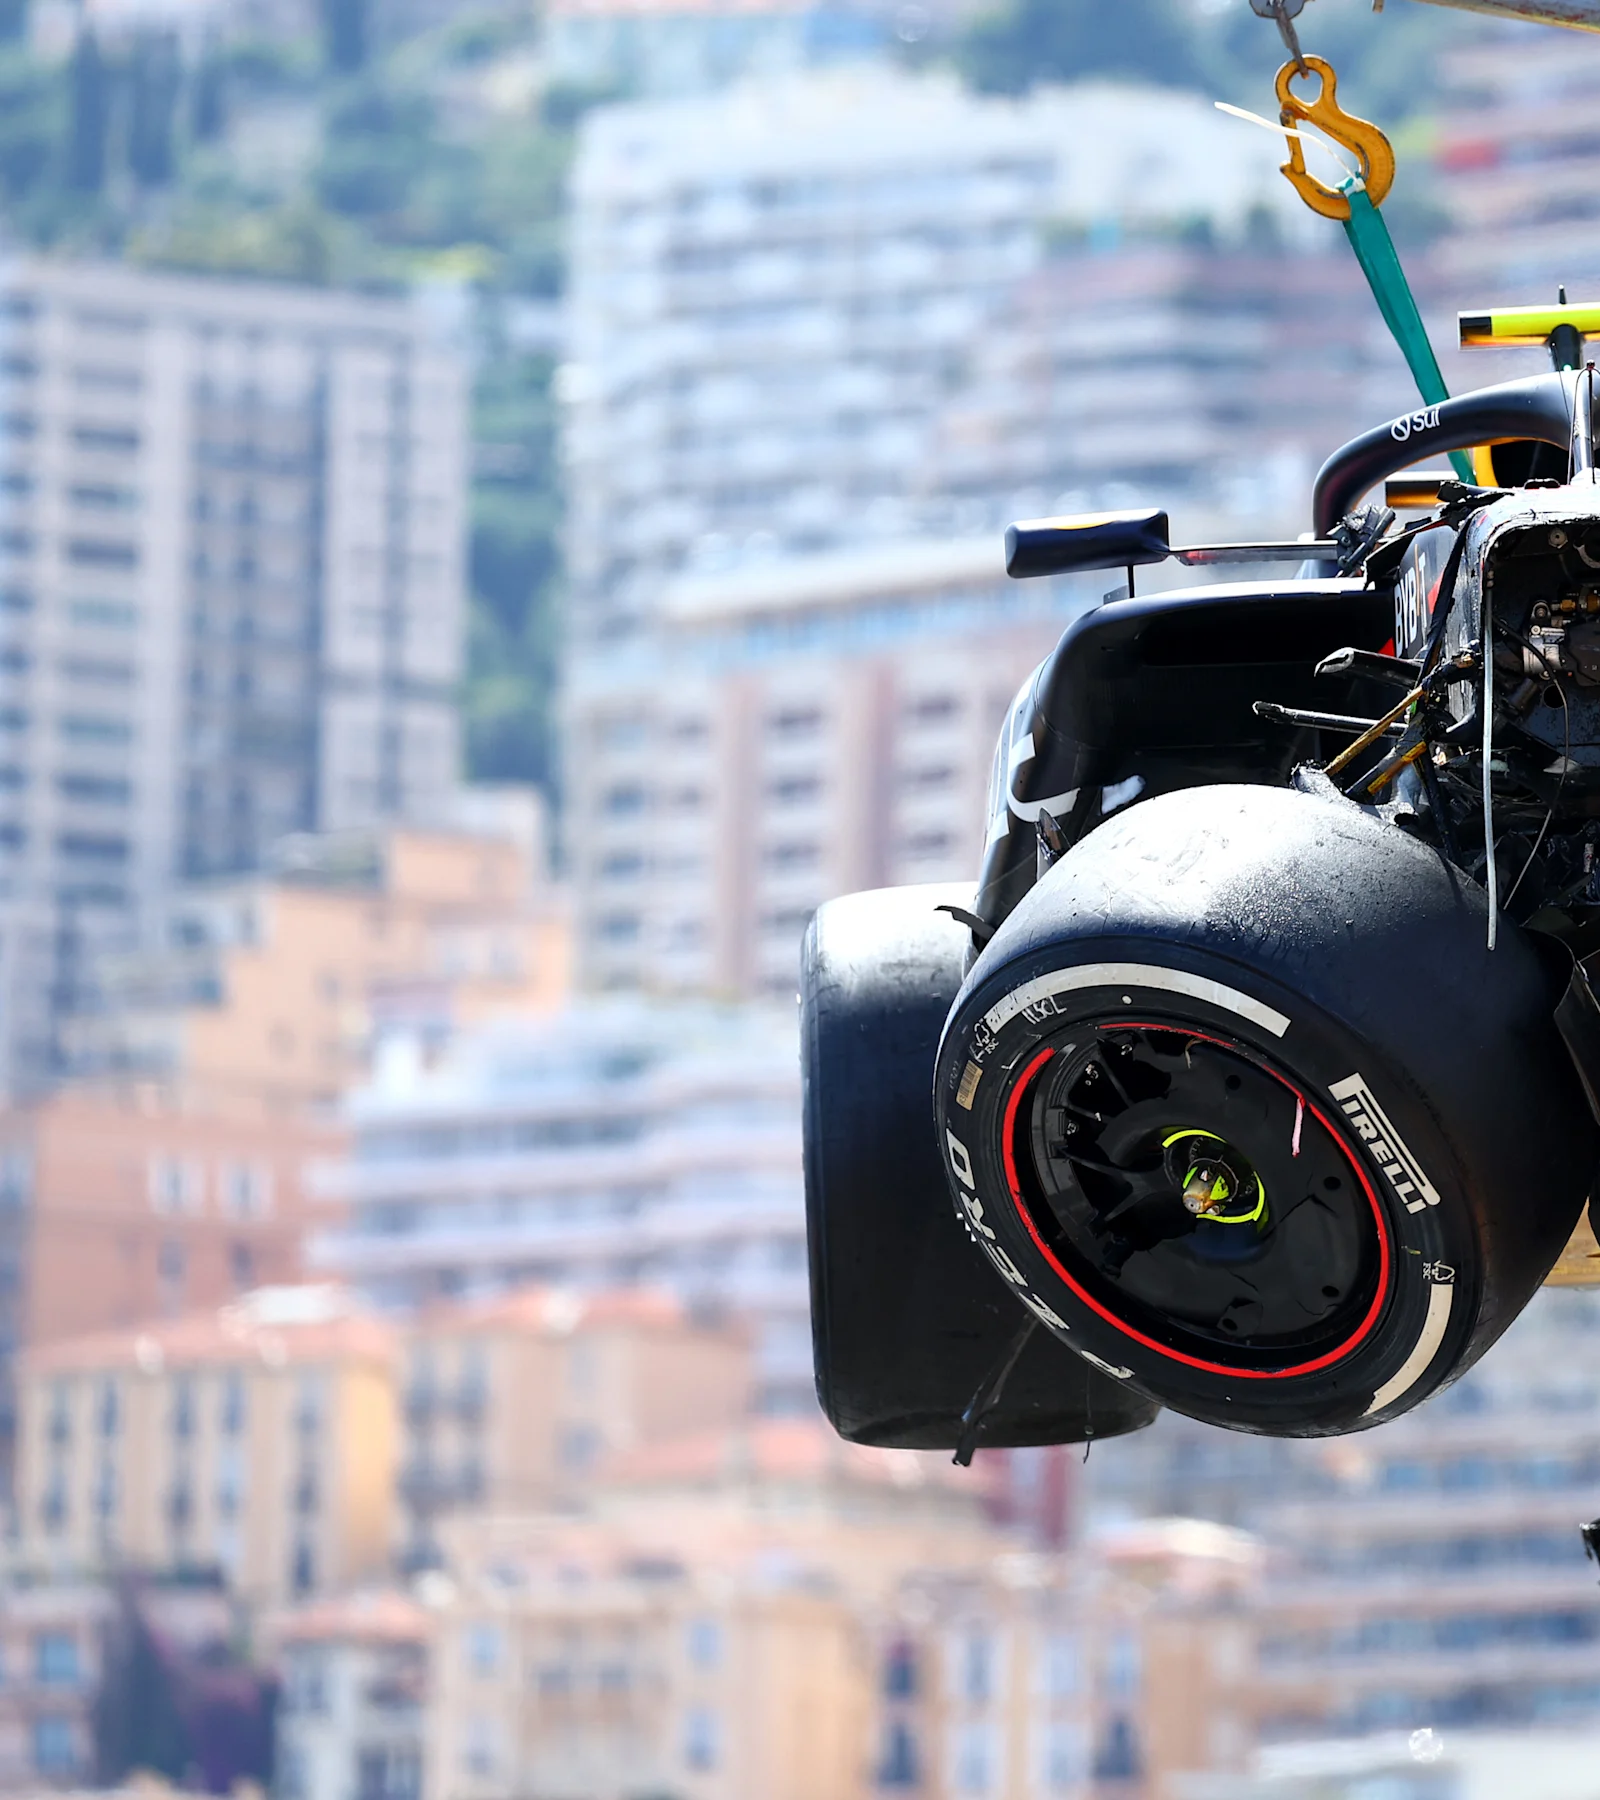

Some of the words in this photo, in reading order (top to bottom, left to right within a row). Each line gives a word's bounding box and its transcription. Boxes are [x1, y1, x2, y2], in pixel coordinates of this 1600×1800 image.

[1412, 406, 1440, 432] Sui
[1394, 543, 1427, 659] BYBIT
[984, 1037, 1000, 1055] FSC
[1327, 1072, 1441, 1215] PIRELLI
[946, 1127, 1071, 1331] ZERO
[1422, 1261, 1431, 1280] FSC
